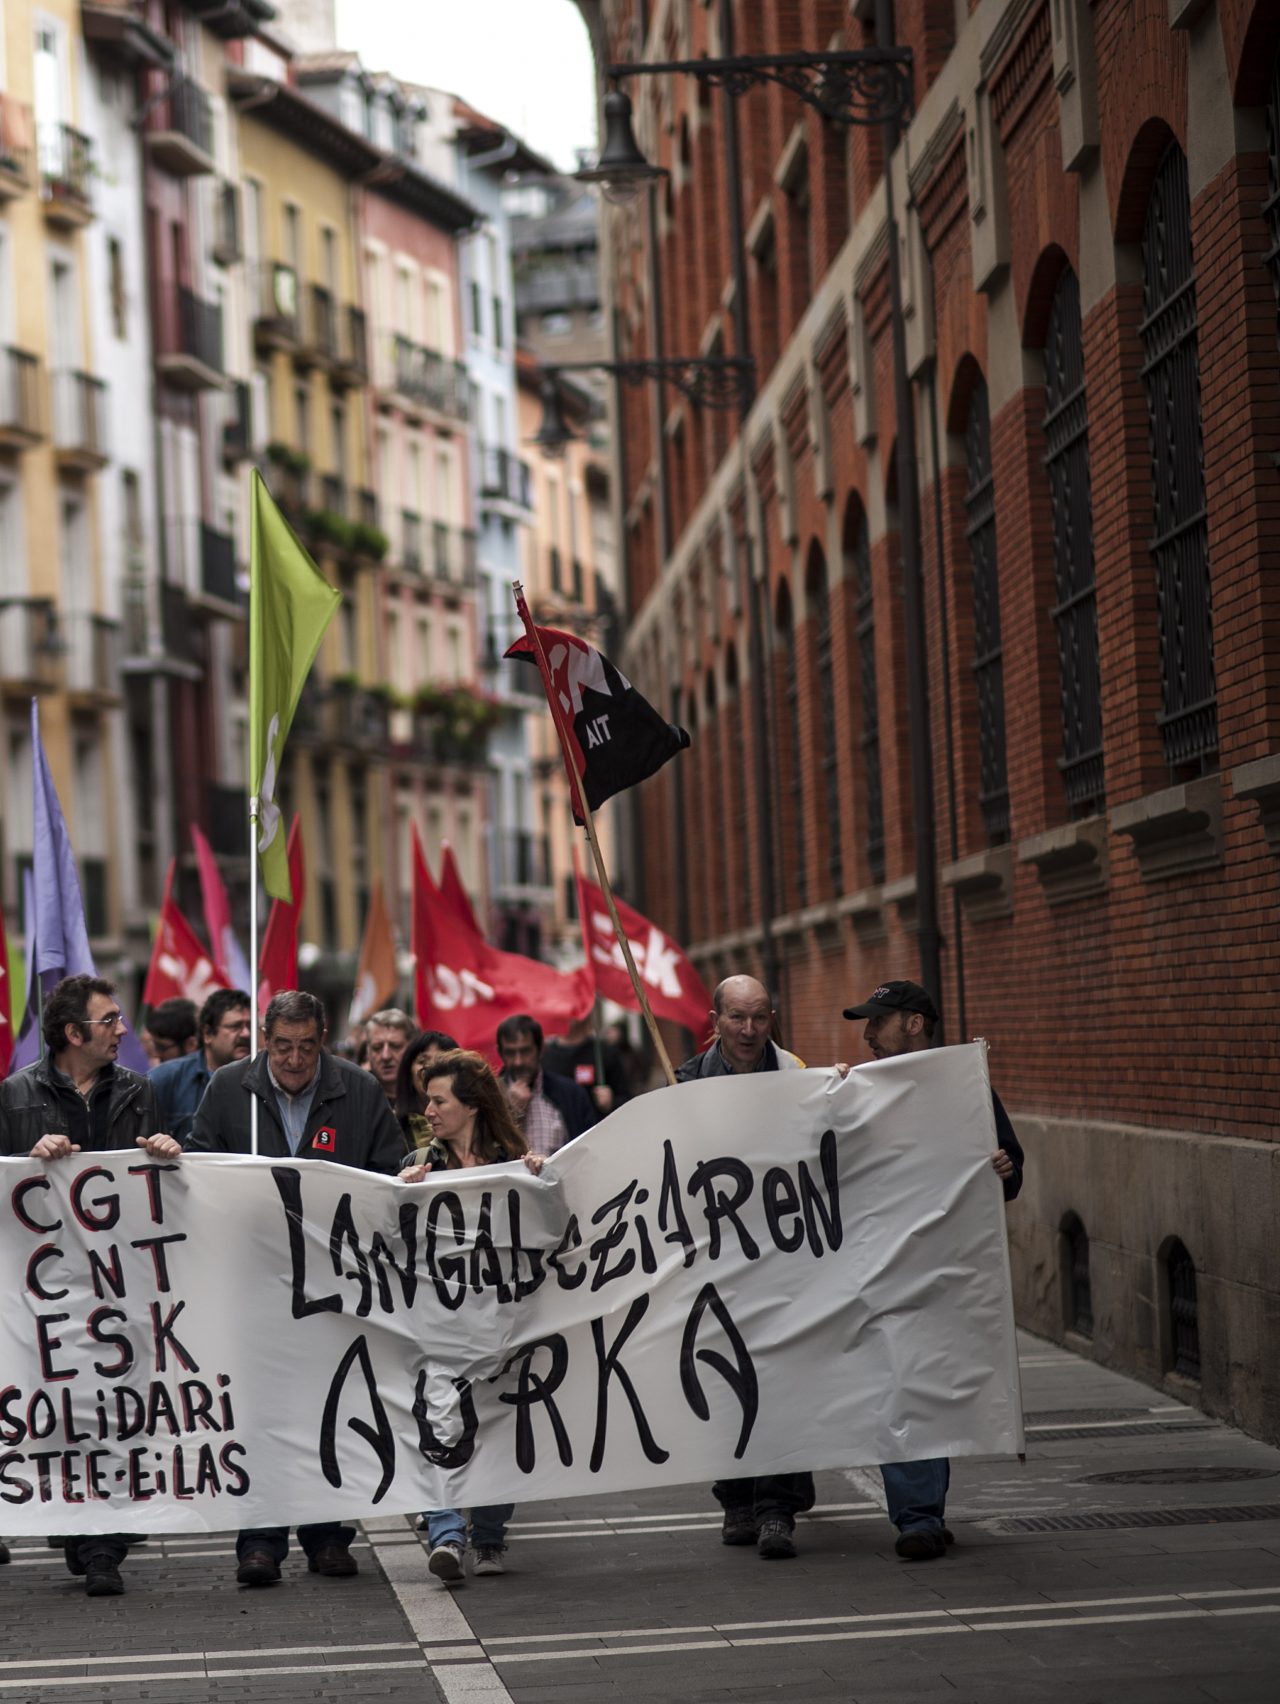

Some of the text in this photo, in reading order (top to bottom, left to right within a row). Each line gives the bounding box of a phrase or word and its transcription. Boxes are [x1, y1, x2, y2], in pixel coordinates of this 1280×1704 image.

[586, 714, 613, 749] AIT
[11, 1164, 180, 1233] CGT
[26, 1233, 187, 1300] CNT
[36, 1300, 200, 1382] ESK
[320, 1282, 759, 1504] AURKA
